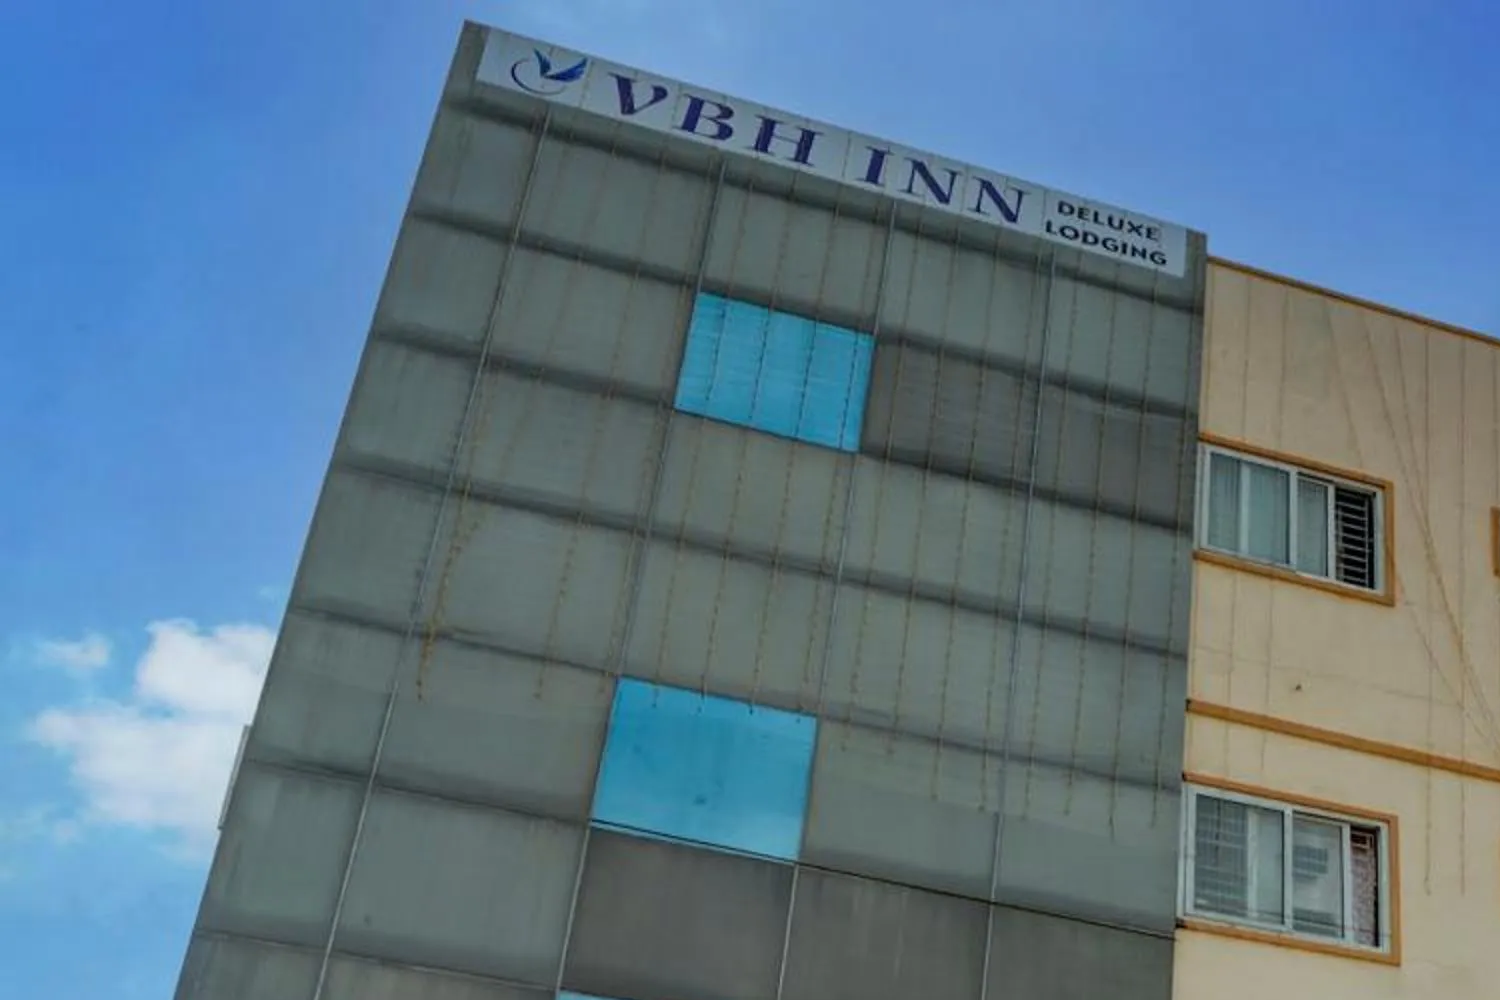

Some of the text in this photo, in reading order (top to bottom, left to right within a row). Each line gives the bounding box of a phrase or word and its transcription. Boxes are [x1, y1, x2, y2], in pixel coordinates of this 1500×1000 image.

[608, 73, 1031, 223] VBH INN
[1045, 220, 1167, 266] LODGING
[1057, 200, 1161, 241] DELUXE
